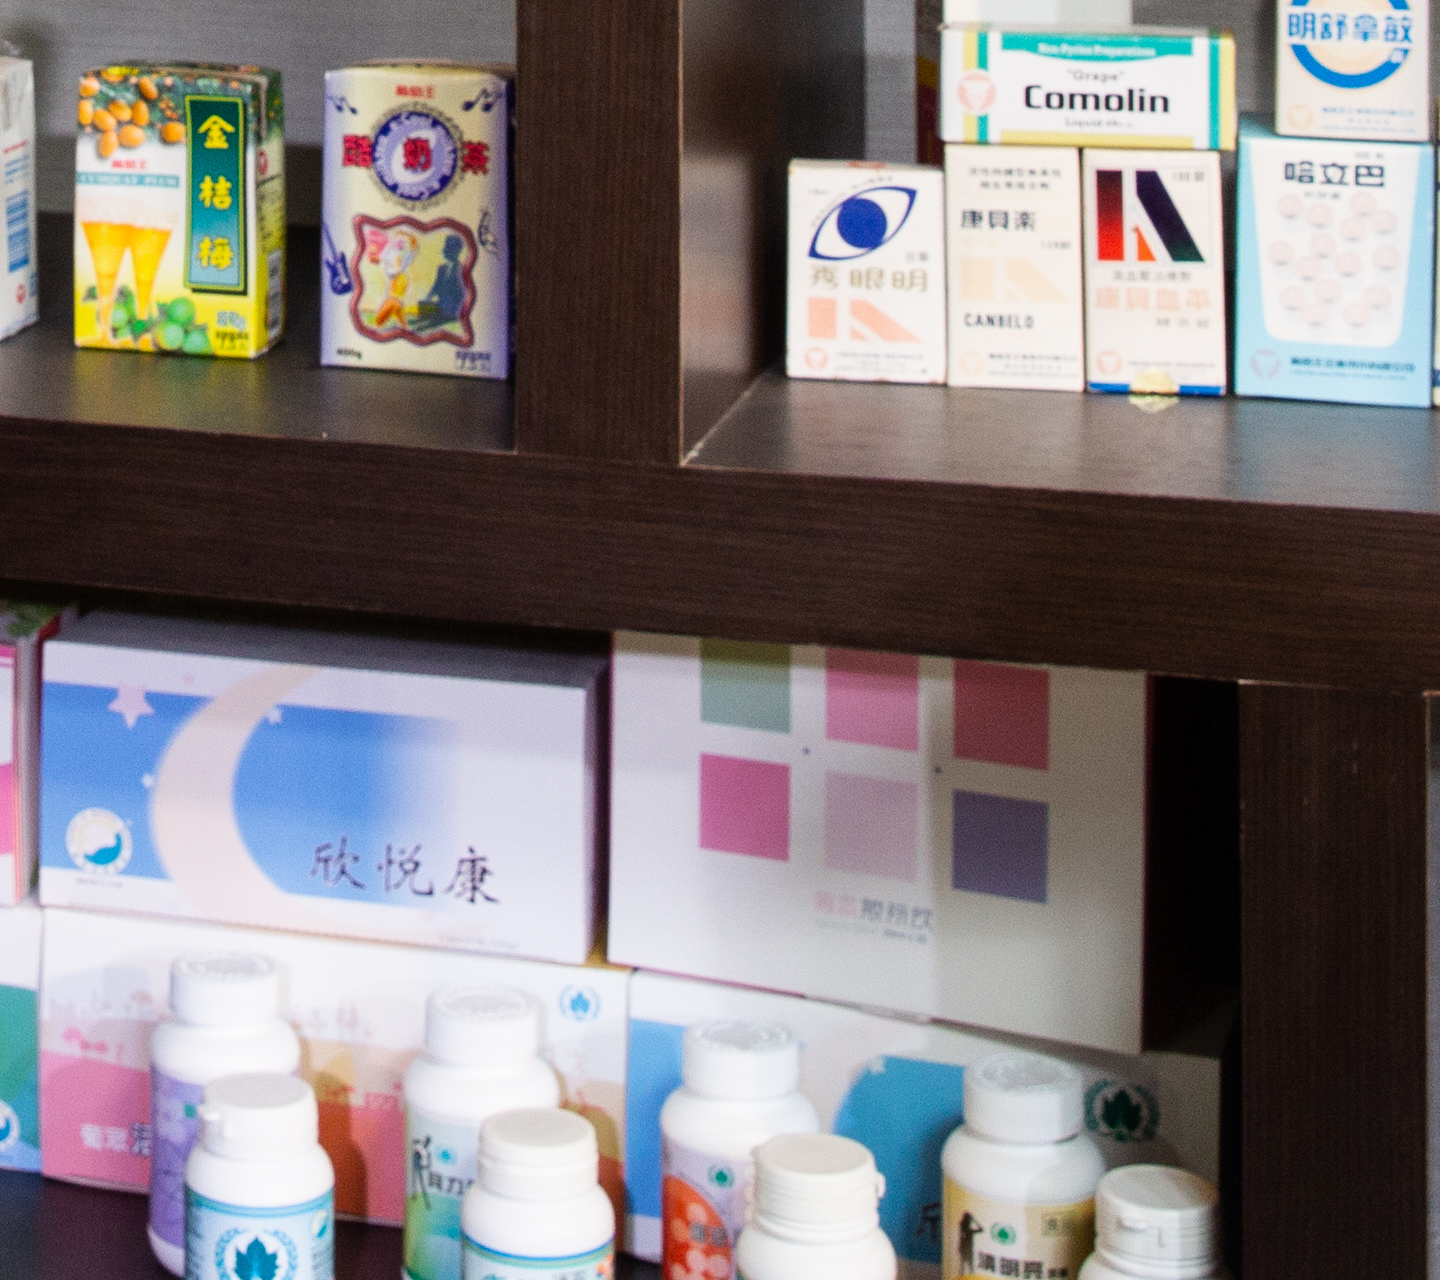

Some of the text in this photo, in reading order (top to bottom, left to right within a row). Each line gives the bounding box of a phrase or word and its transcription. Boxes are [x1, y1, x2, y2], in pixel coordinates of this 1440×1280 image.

[1287, 13, 1414, 45] 明舒拿敏
[1024, 85, 1170, 114] Comolin
[1285, 161, 1385, 187] 哈立巴
[197, 114, 236, 270] 金桔梅
[964, 313, 1035, 329] CANBELO
[310, 834, 502, 906] 欣悅康
